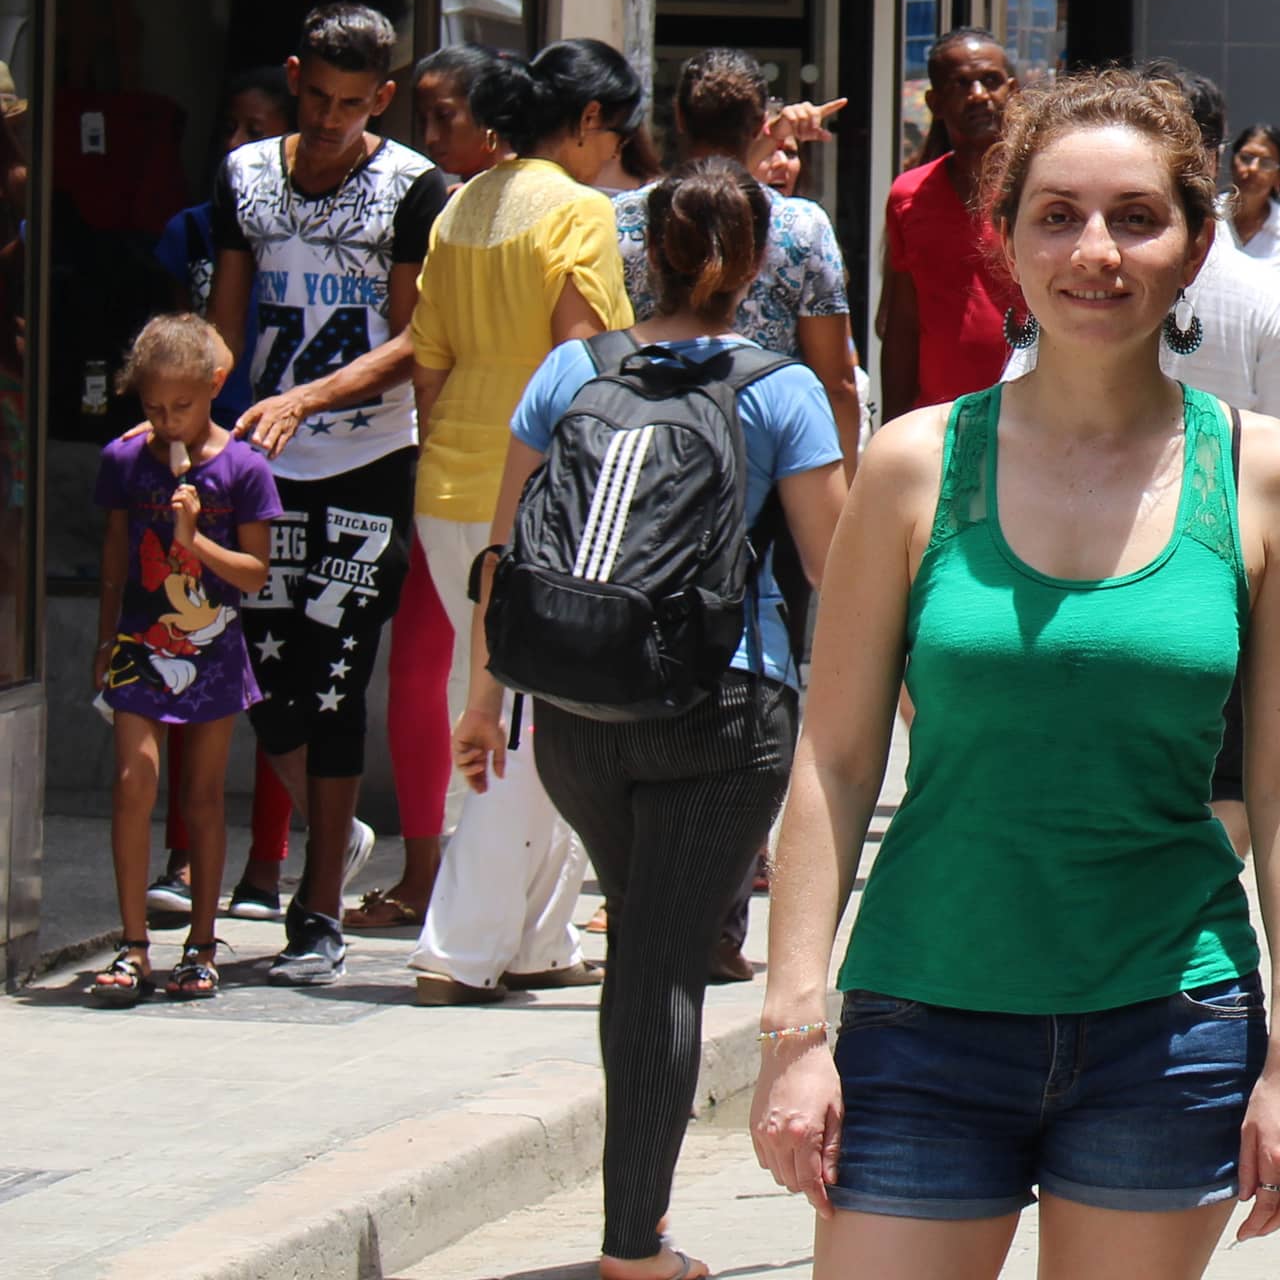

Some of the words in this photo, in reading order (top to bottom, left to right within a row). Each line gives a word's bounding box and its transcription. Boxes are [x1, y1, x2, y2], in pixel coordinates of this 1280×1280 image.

[304, 272, 381, 305] YORK
[255, 303, 382, 412] 74
[326, 512, 388, 534] CHICAGO
[319, 556, 379, 586] YORK
